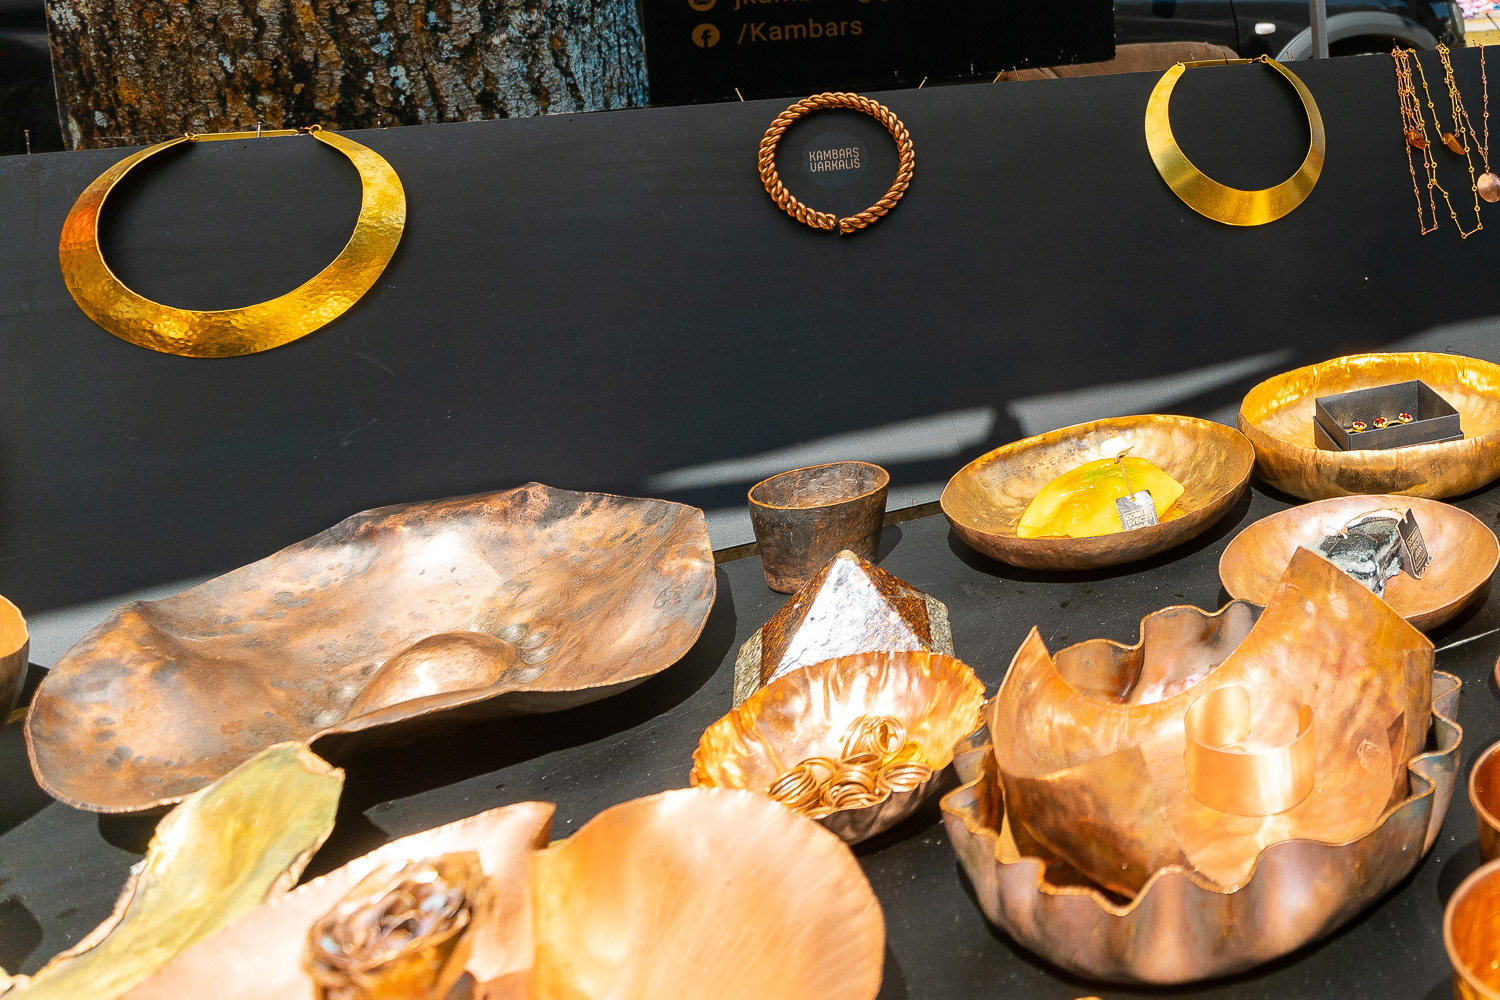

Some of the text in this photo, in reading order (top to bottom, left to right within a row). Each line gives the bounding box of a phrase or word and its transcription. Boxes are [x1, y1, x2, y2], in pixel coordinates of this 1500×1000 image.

[737, 18, 863, 44] /Kambars
[809, 147, 859, 161] KAMBARS
[809, 158, 861, 172] VARKALIS
